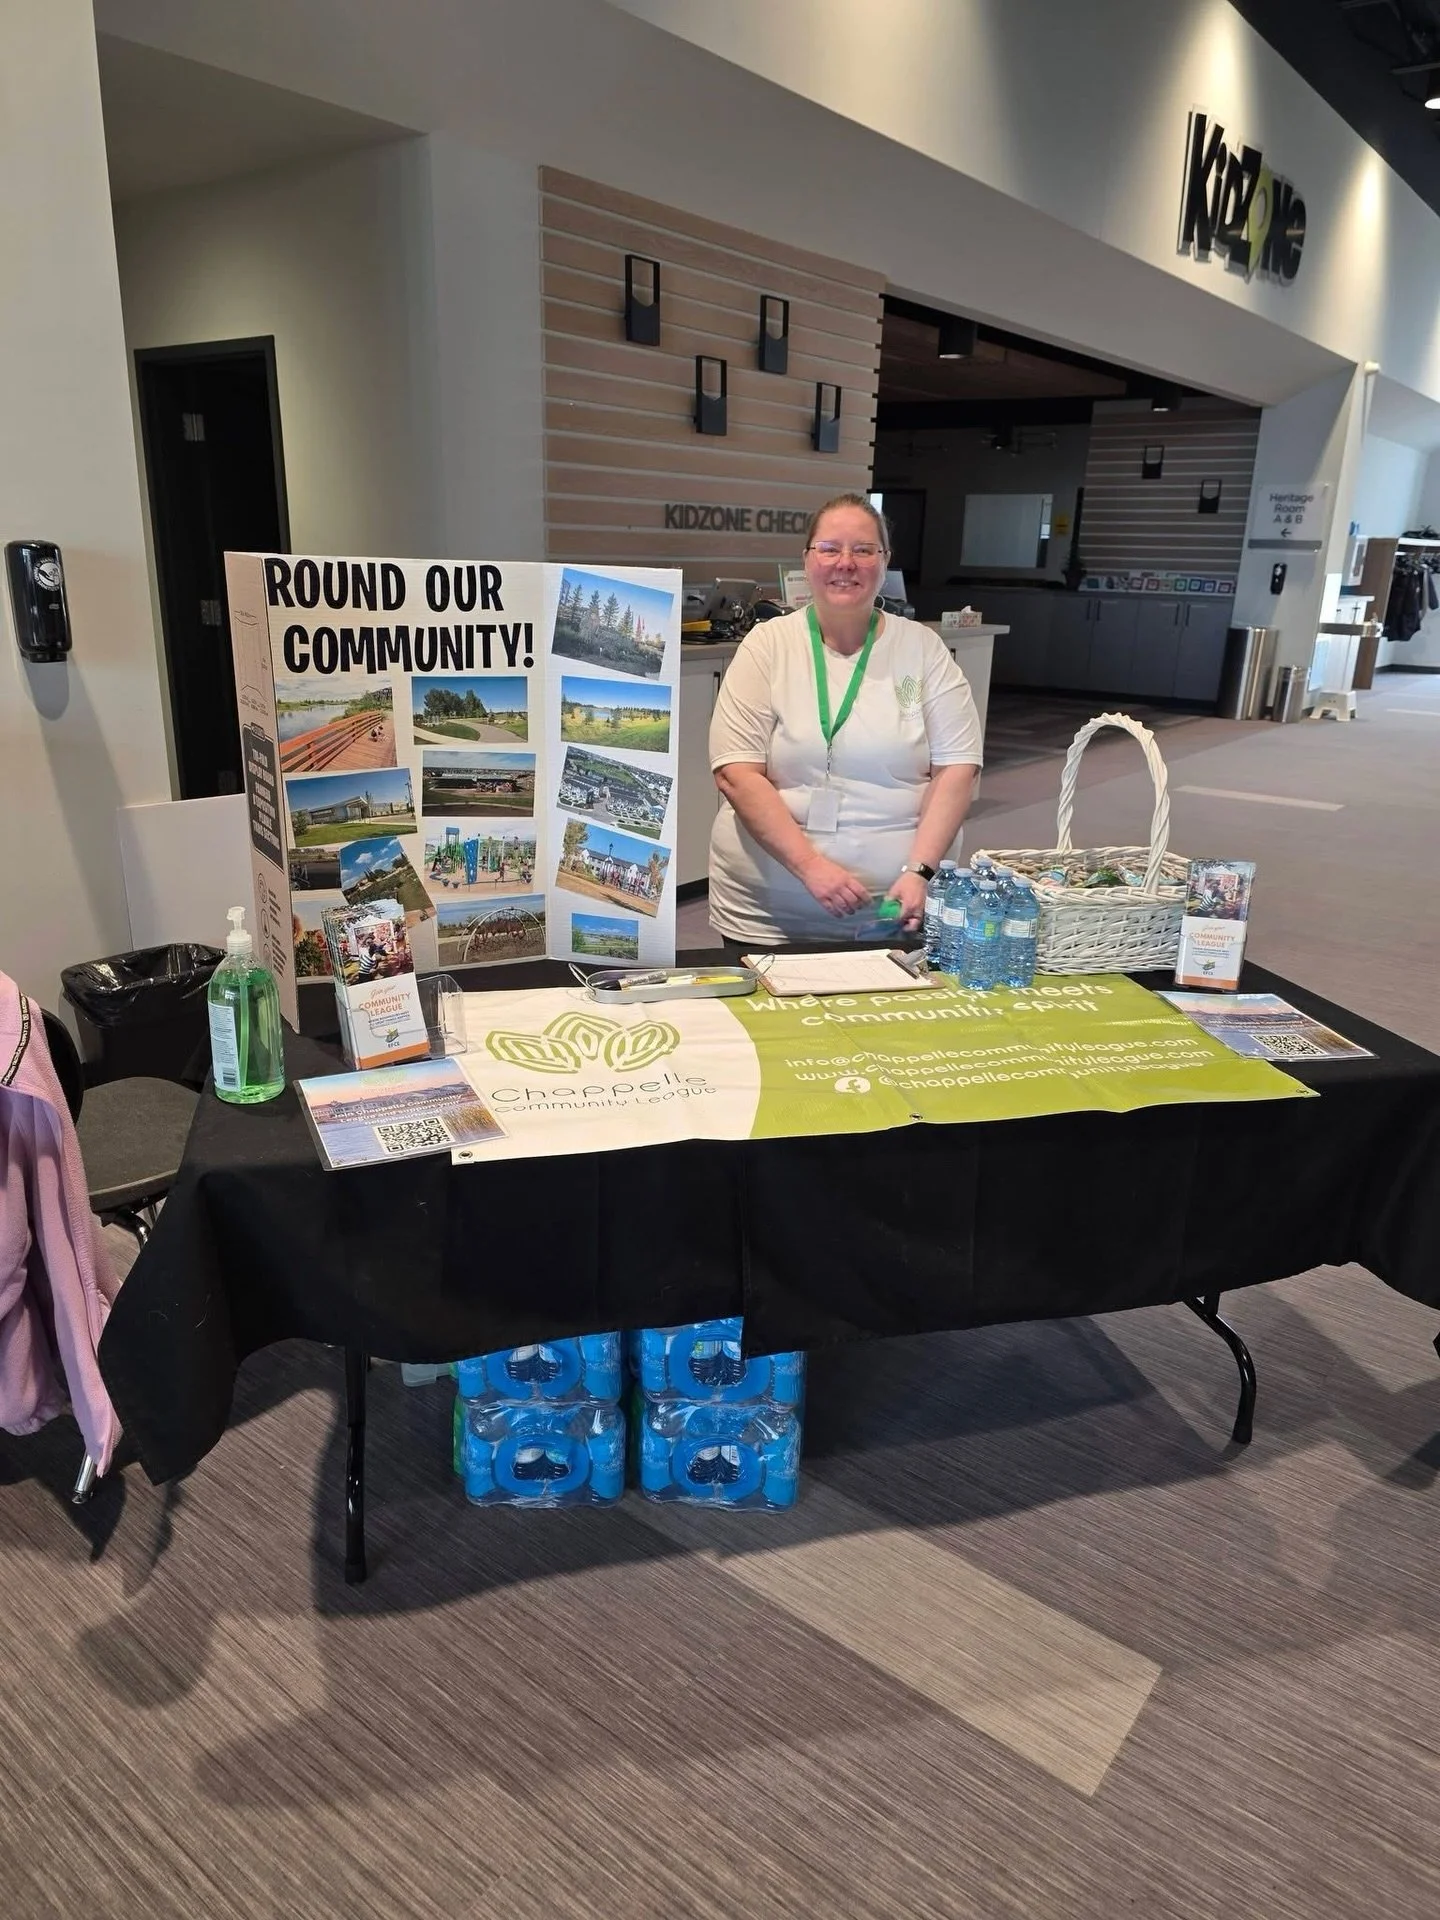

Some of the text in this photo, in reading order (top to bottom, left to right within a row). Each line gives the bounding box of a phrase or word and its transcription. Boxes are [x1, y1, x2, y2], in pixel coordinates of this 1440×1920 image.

[1269, 493, 1314, 504] Heritage
[1273, 503, 1305, 513] Room
[664, 503, 753, 532] KIDZONE
[1273, 514, 1303, 524] A & B
[264, 557, 504, 612] ROUND OUR
[283, 623, 534, 674] COMMUNITY!
[1190, 932, 1236, 942] COMMUNITY
[1197, 940, 1226, 948] LEAGUE
[358, 992, 411, 1009] COMMUNITY
[745, 993, 858, 1012] Where
[1009, 983, 1114, 996] meets
[1013, 999, 1099, 1013] spirit
[370, 1003, 403, 1017] LEAGUE
[491, 1073, 707, 1102] Chappelle
[340, 1114, 376, 1122] League
[398, 1104, 436, 1115] support
[436, 1100, 461, 1109] your
[356, 1103, 405, 1115] Chappelle
[407, 1094, 462, 1106] Community
